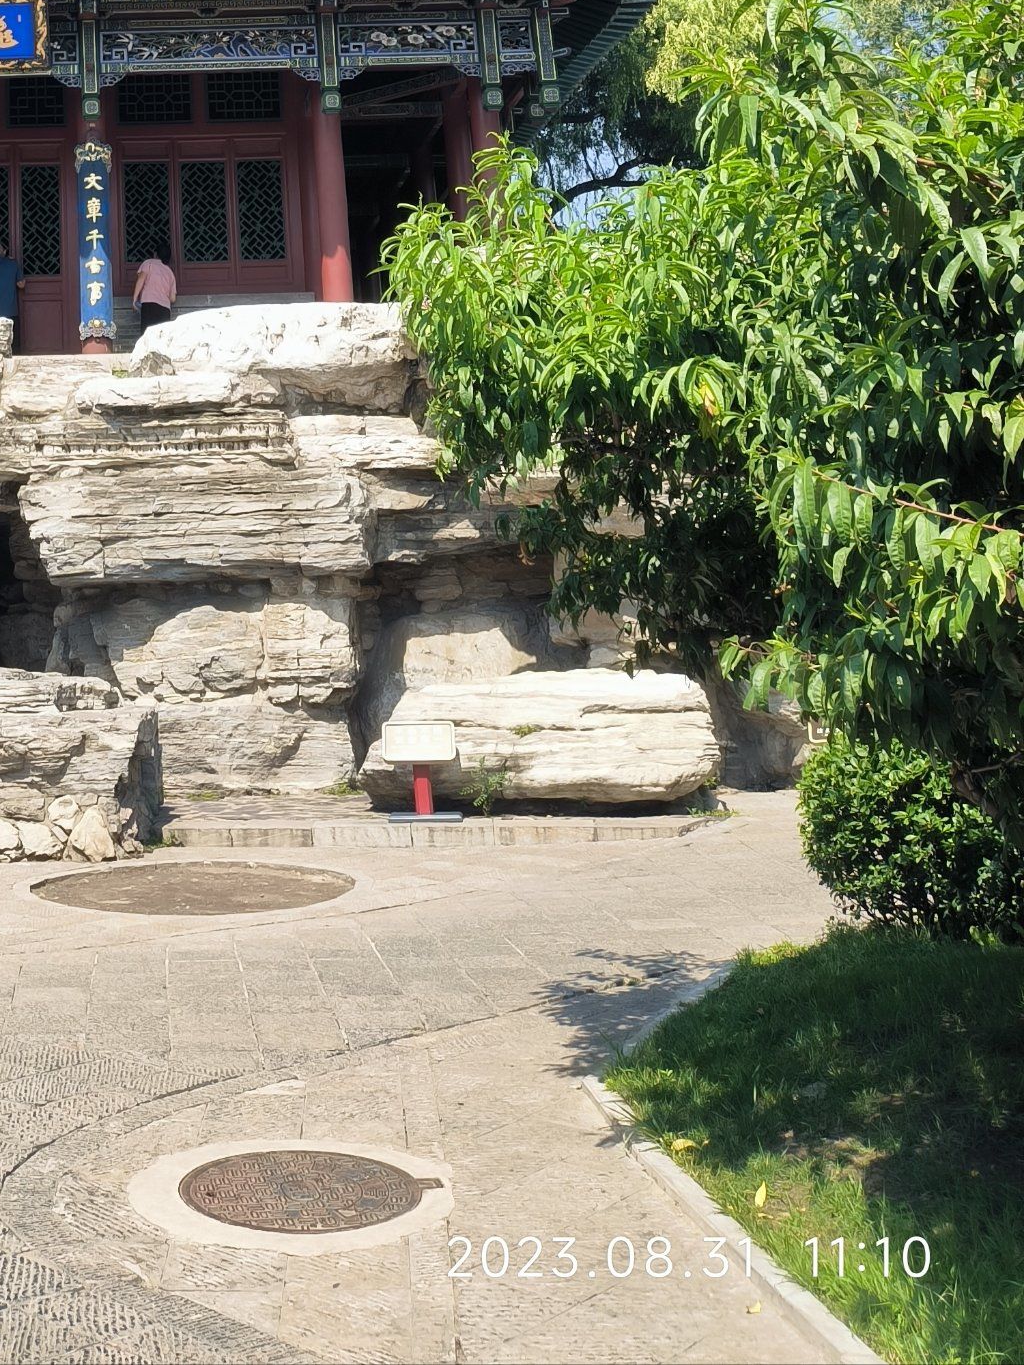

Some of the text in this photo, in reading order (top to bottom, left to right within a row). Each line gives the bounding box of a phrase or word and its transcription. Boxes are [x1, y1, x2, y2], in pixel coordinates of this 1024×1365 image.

[83, 173, 106, 307] 文章千古事
